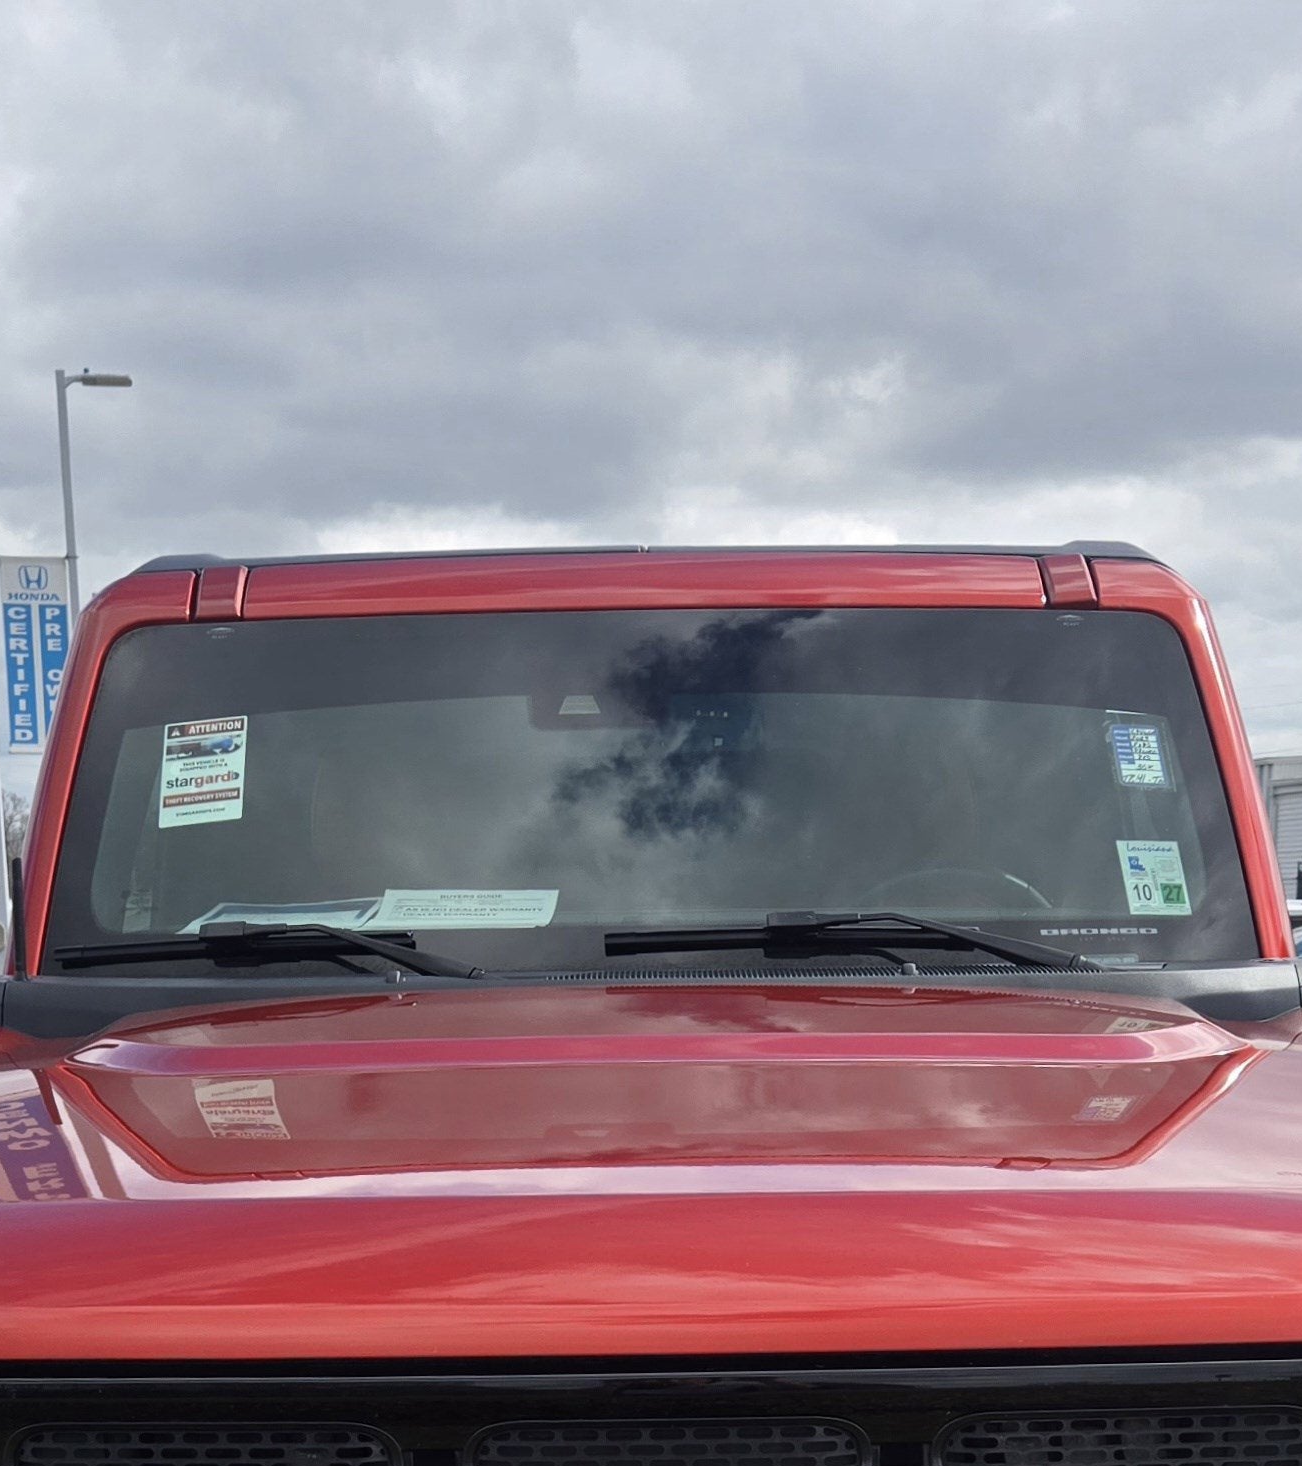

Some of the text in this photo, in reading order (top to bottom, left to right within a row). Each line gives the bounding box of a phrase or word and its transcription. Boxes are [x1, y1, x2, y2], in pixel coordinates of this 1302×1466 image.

[7, 592, 60, 601] HONDA
[44, 607, 63, 652] PRE
[7, 606, 34, 742] CERTIFIED
[188, 720, 242, 735] ATTENTION
[1126, 842, 1174, 853] Louisiana
[1132, 883, 1152, 901] 10
[1163, 884, 1182, 902] 27
